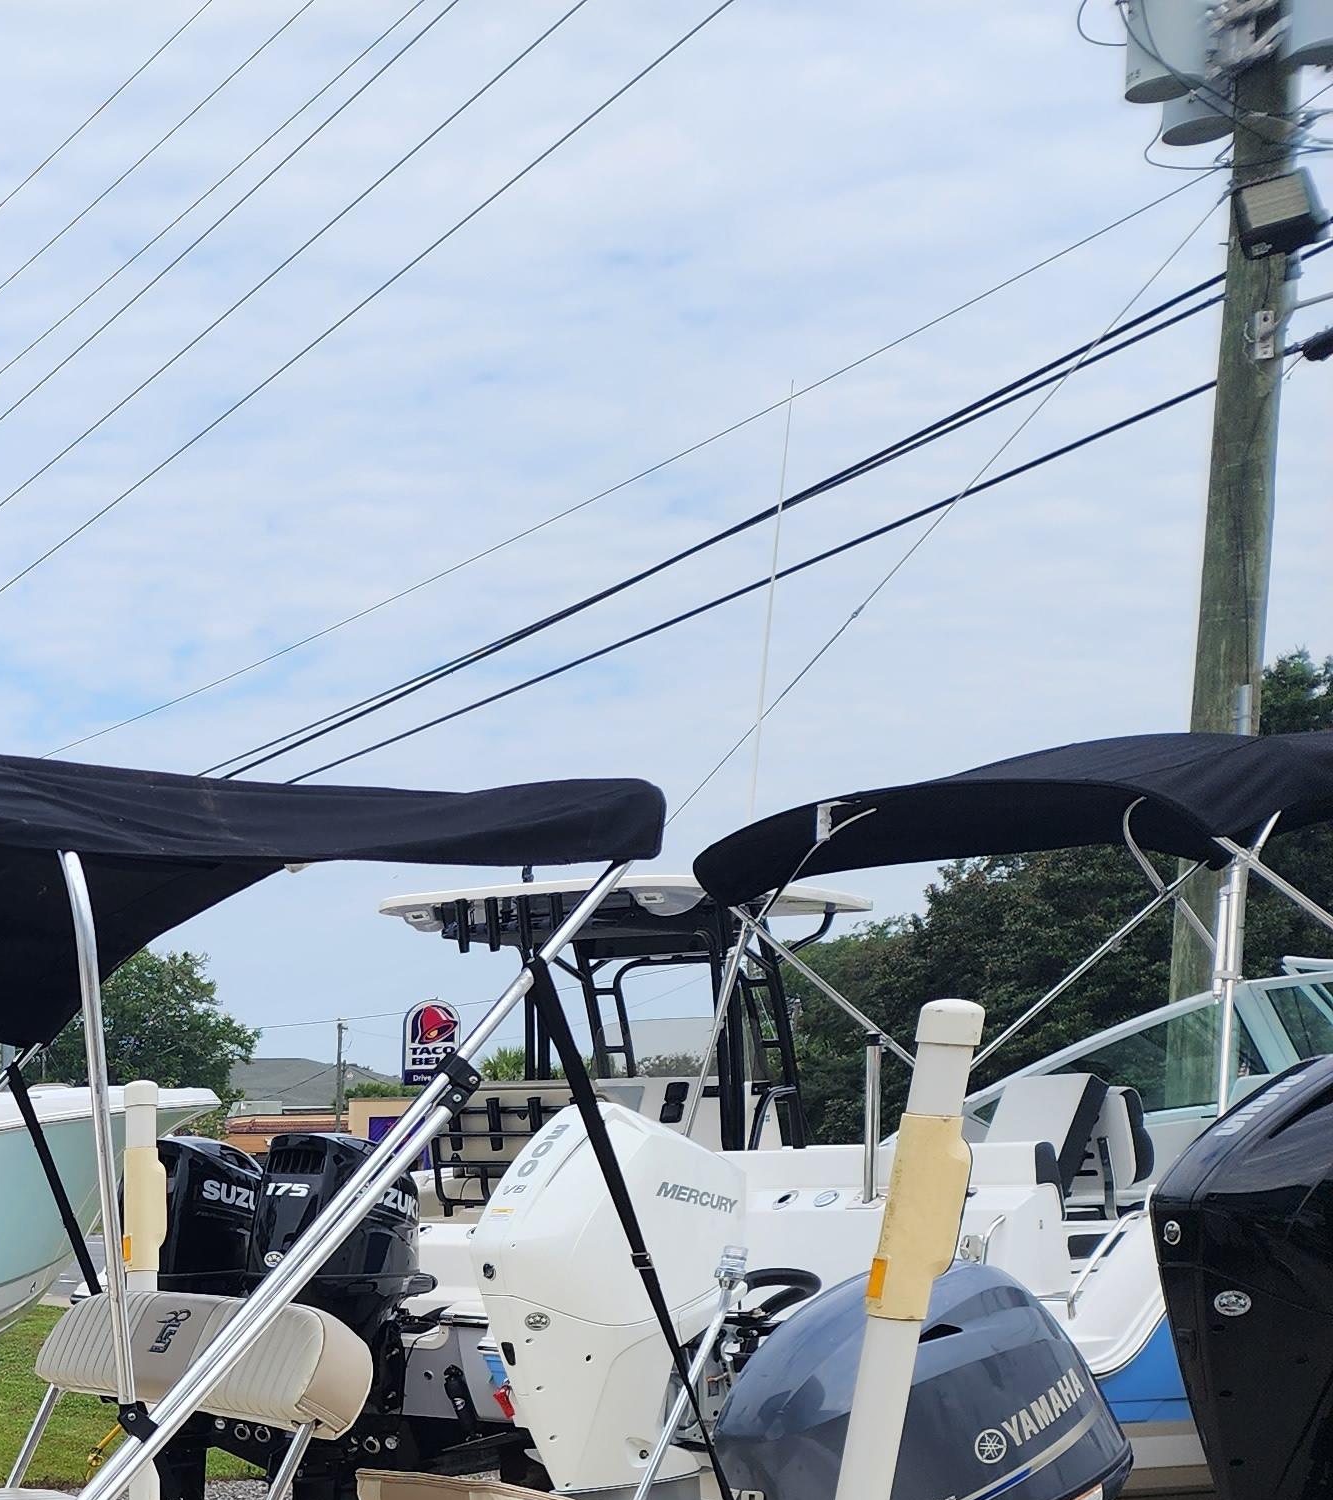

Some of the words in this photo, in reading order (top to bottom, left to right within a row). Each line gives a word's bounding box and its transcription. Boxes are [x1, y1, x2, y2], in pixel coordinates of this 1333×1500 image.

[409, 1046, 456, 1055] TACO
[517, 1124, 570, 1178] 300
[265, 1182, 311, 1198] 175
[655, 1181, 739, 1214] MERCURY
[1000, 1367, 1086, 1447] YAMAHA
